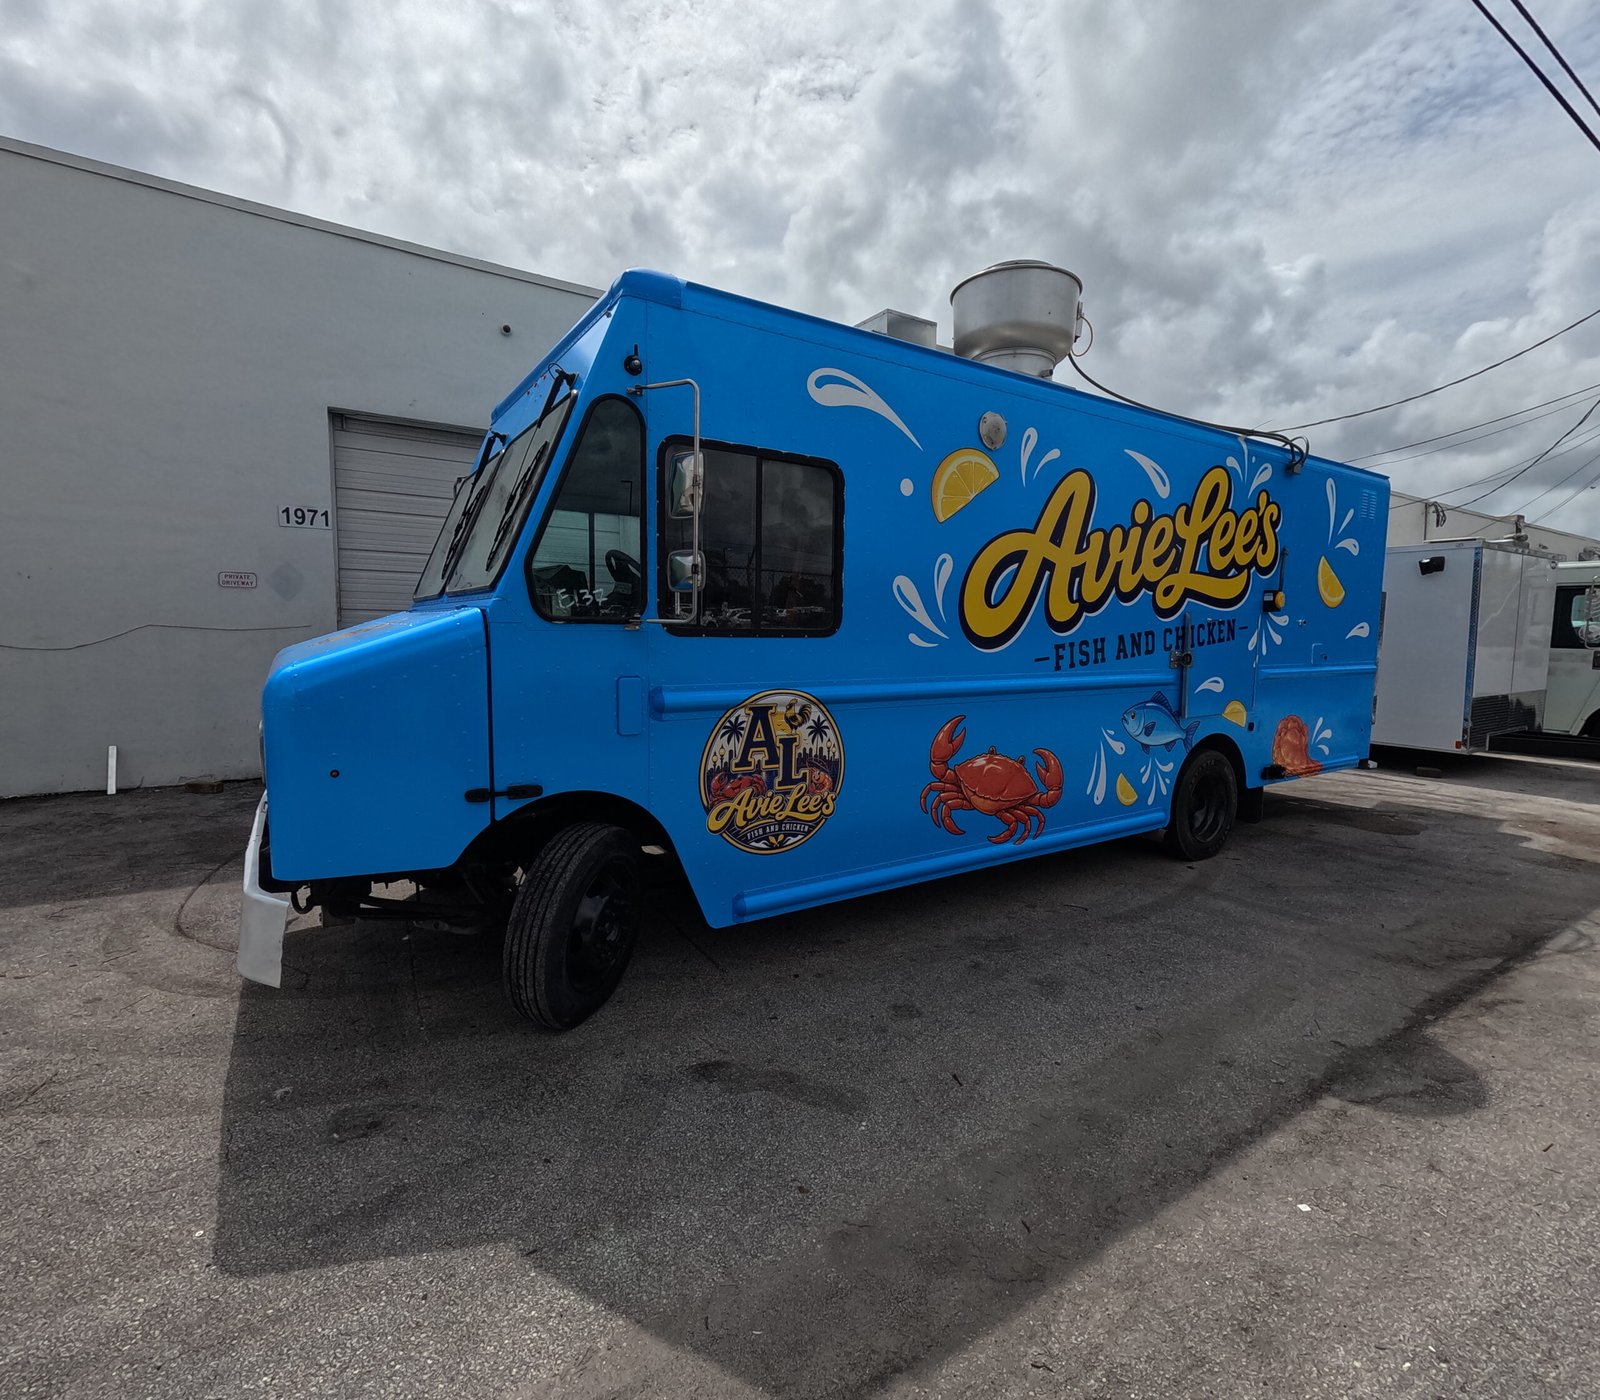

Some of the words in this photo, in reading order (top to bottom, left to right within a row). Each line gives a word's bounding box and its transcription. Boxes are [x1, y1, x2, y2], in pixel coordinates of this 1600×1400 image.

[281, 506, 330, 528] 1971
[1053, 636, 1107, 671] FISH
[1115, 629, 1156, 660] AND
[1163, 618, 1237, 652] CHICKEN
[747, 828, 764, 840] FISH
[766, 825, 779, 833] AND
[781, 823, 809, 832] CHICKEN
